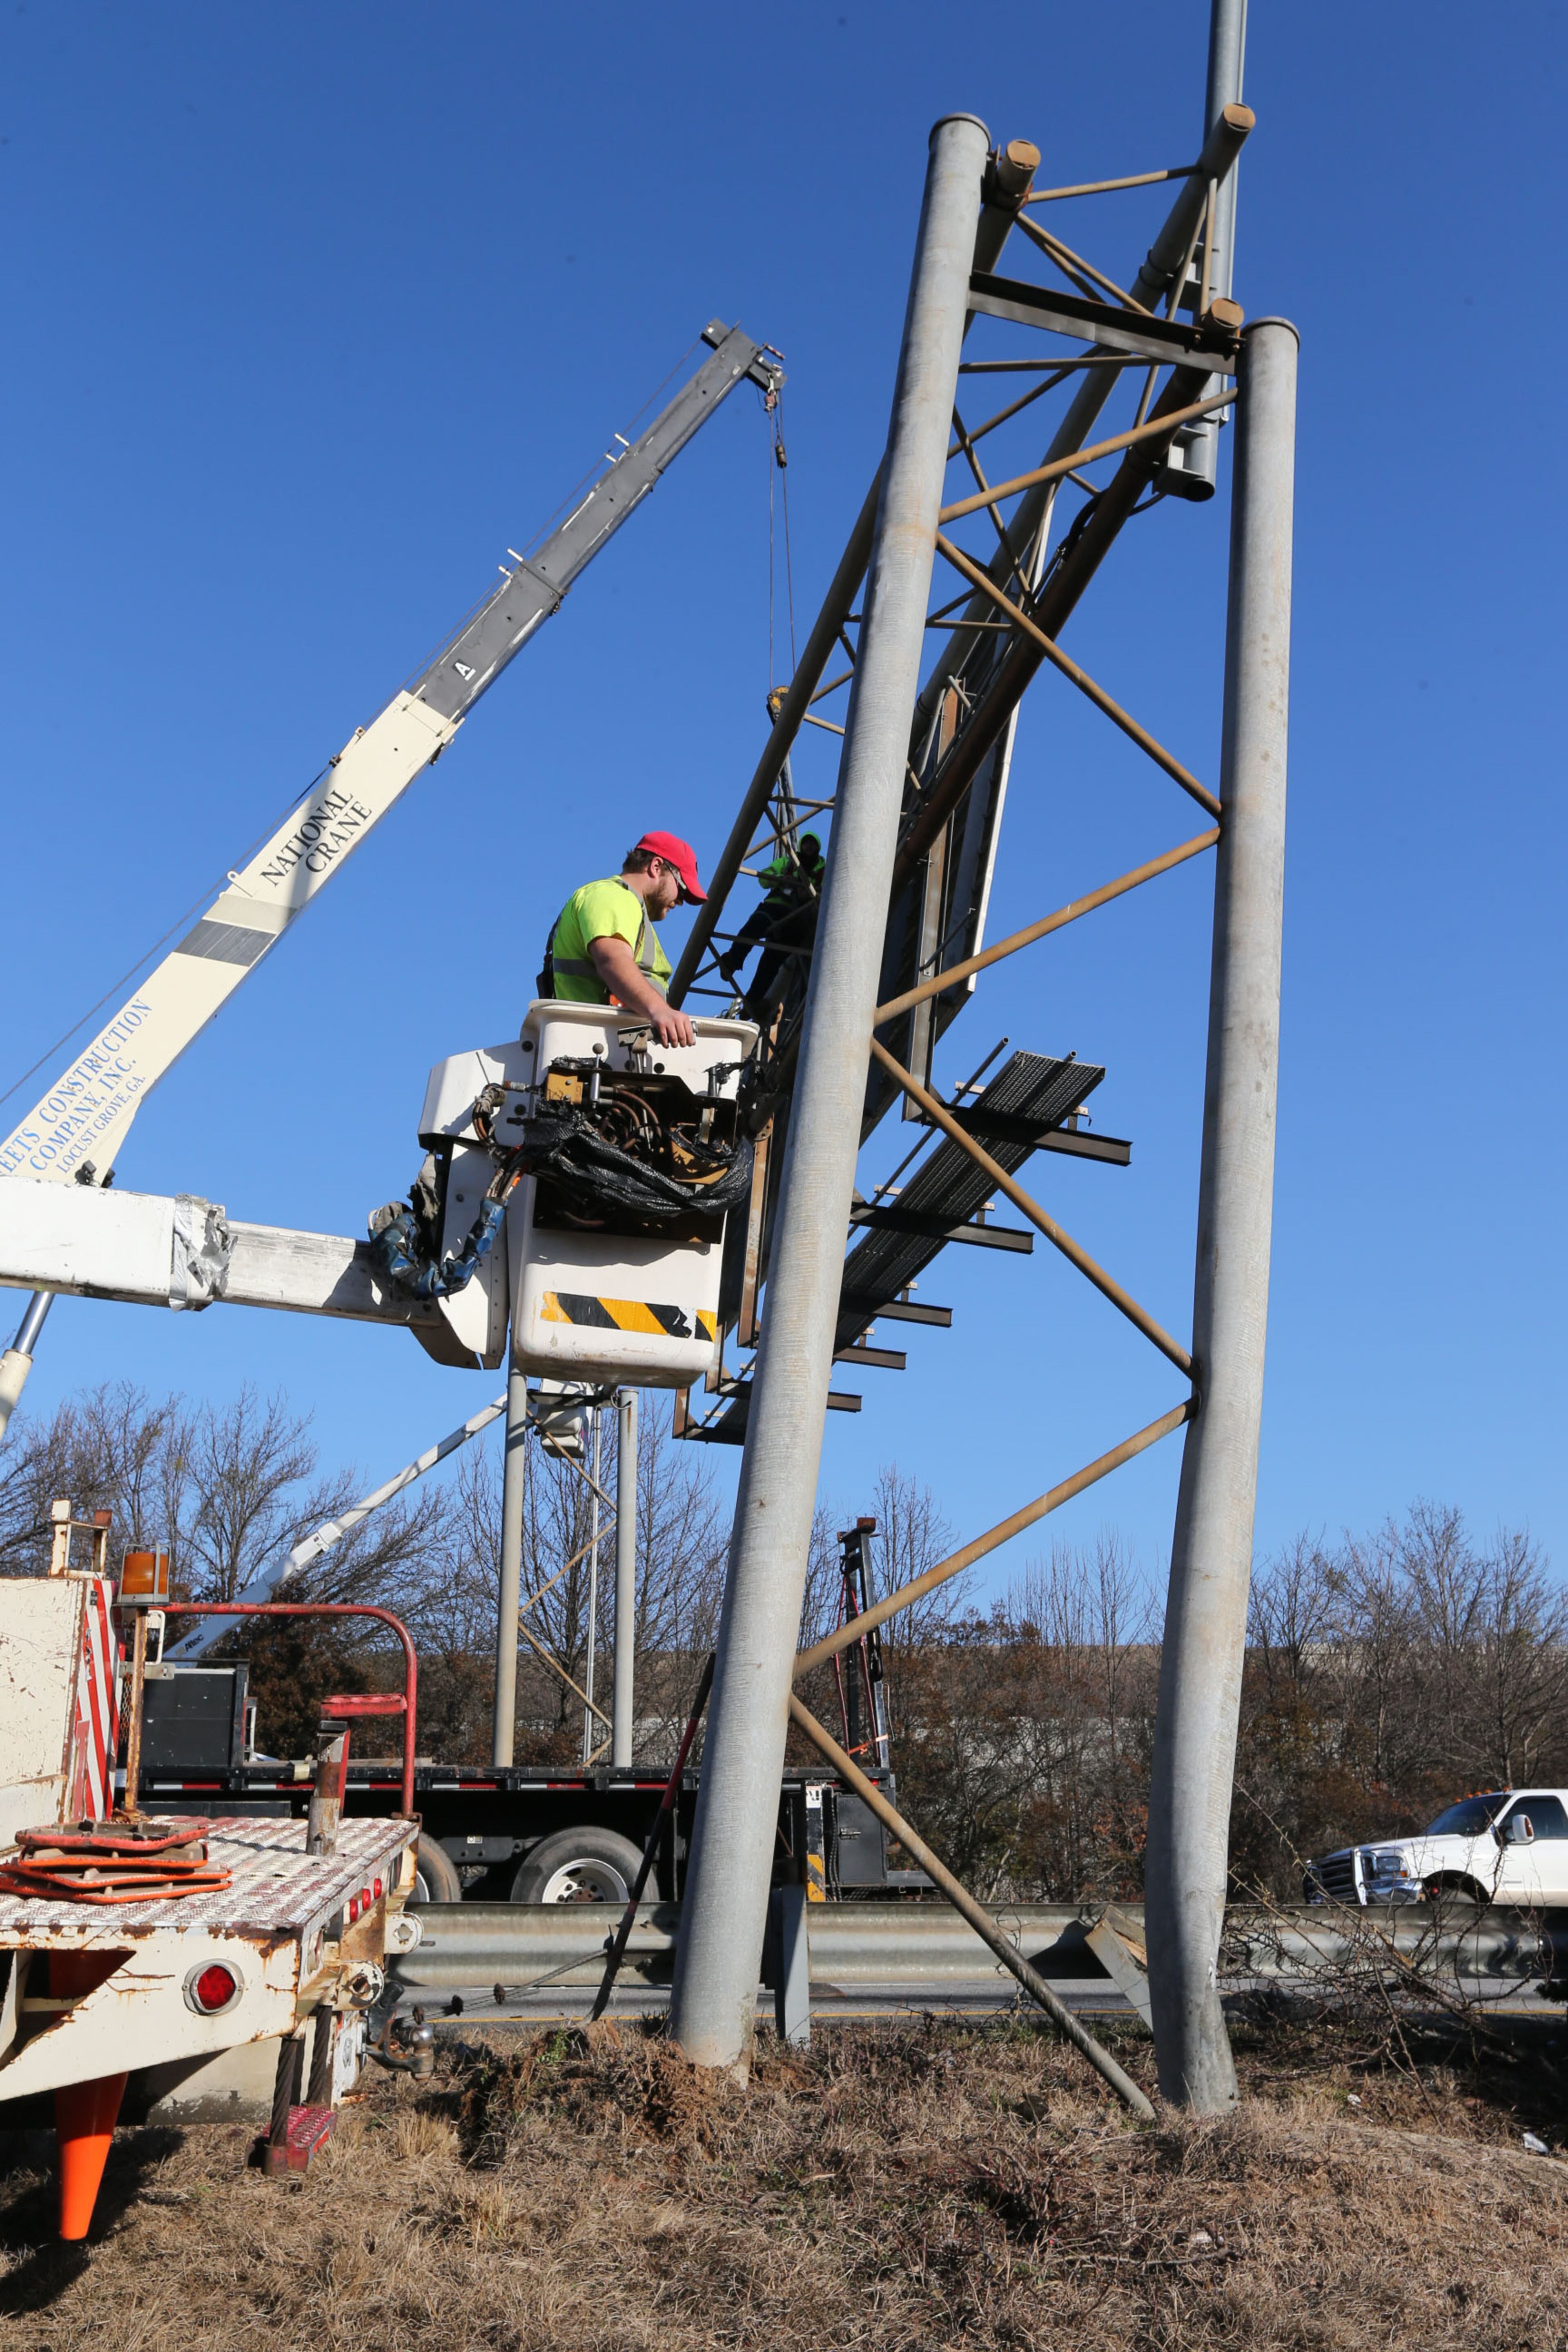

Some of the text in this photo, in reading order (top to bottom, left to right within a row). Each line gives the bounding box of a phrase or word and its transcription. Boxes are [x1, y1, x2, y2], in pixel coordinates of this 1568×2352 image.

[455, 662, 471, 677] A
[259, 789, 353, 886] NATIONAL
[305, 801, 372, 873] CRANE
[0, 998, 152, 1173] EETS CONSTRUCTION
[29, 1057, 136, 1170] COMPANY, INC.
[56, 1076, 146, 1173] LOCUST GROVE, GA.
[185, 1634, 204, 1652] Altec
